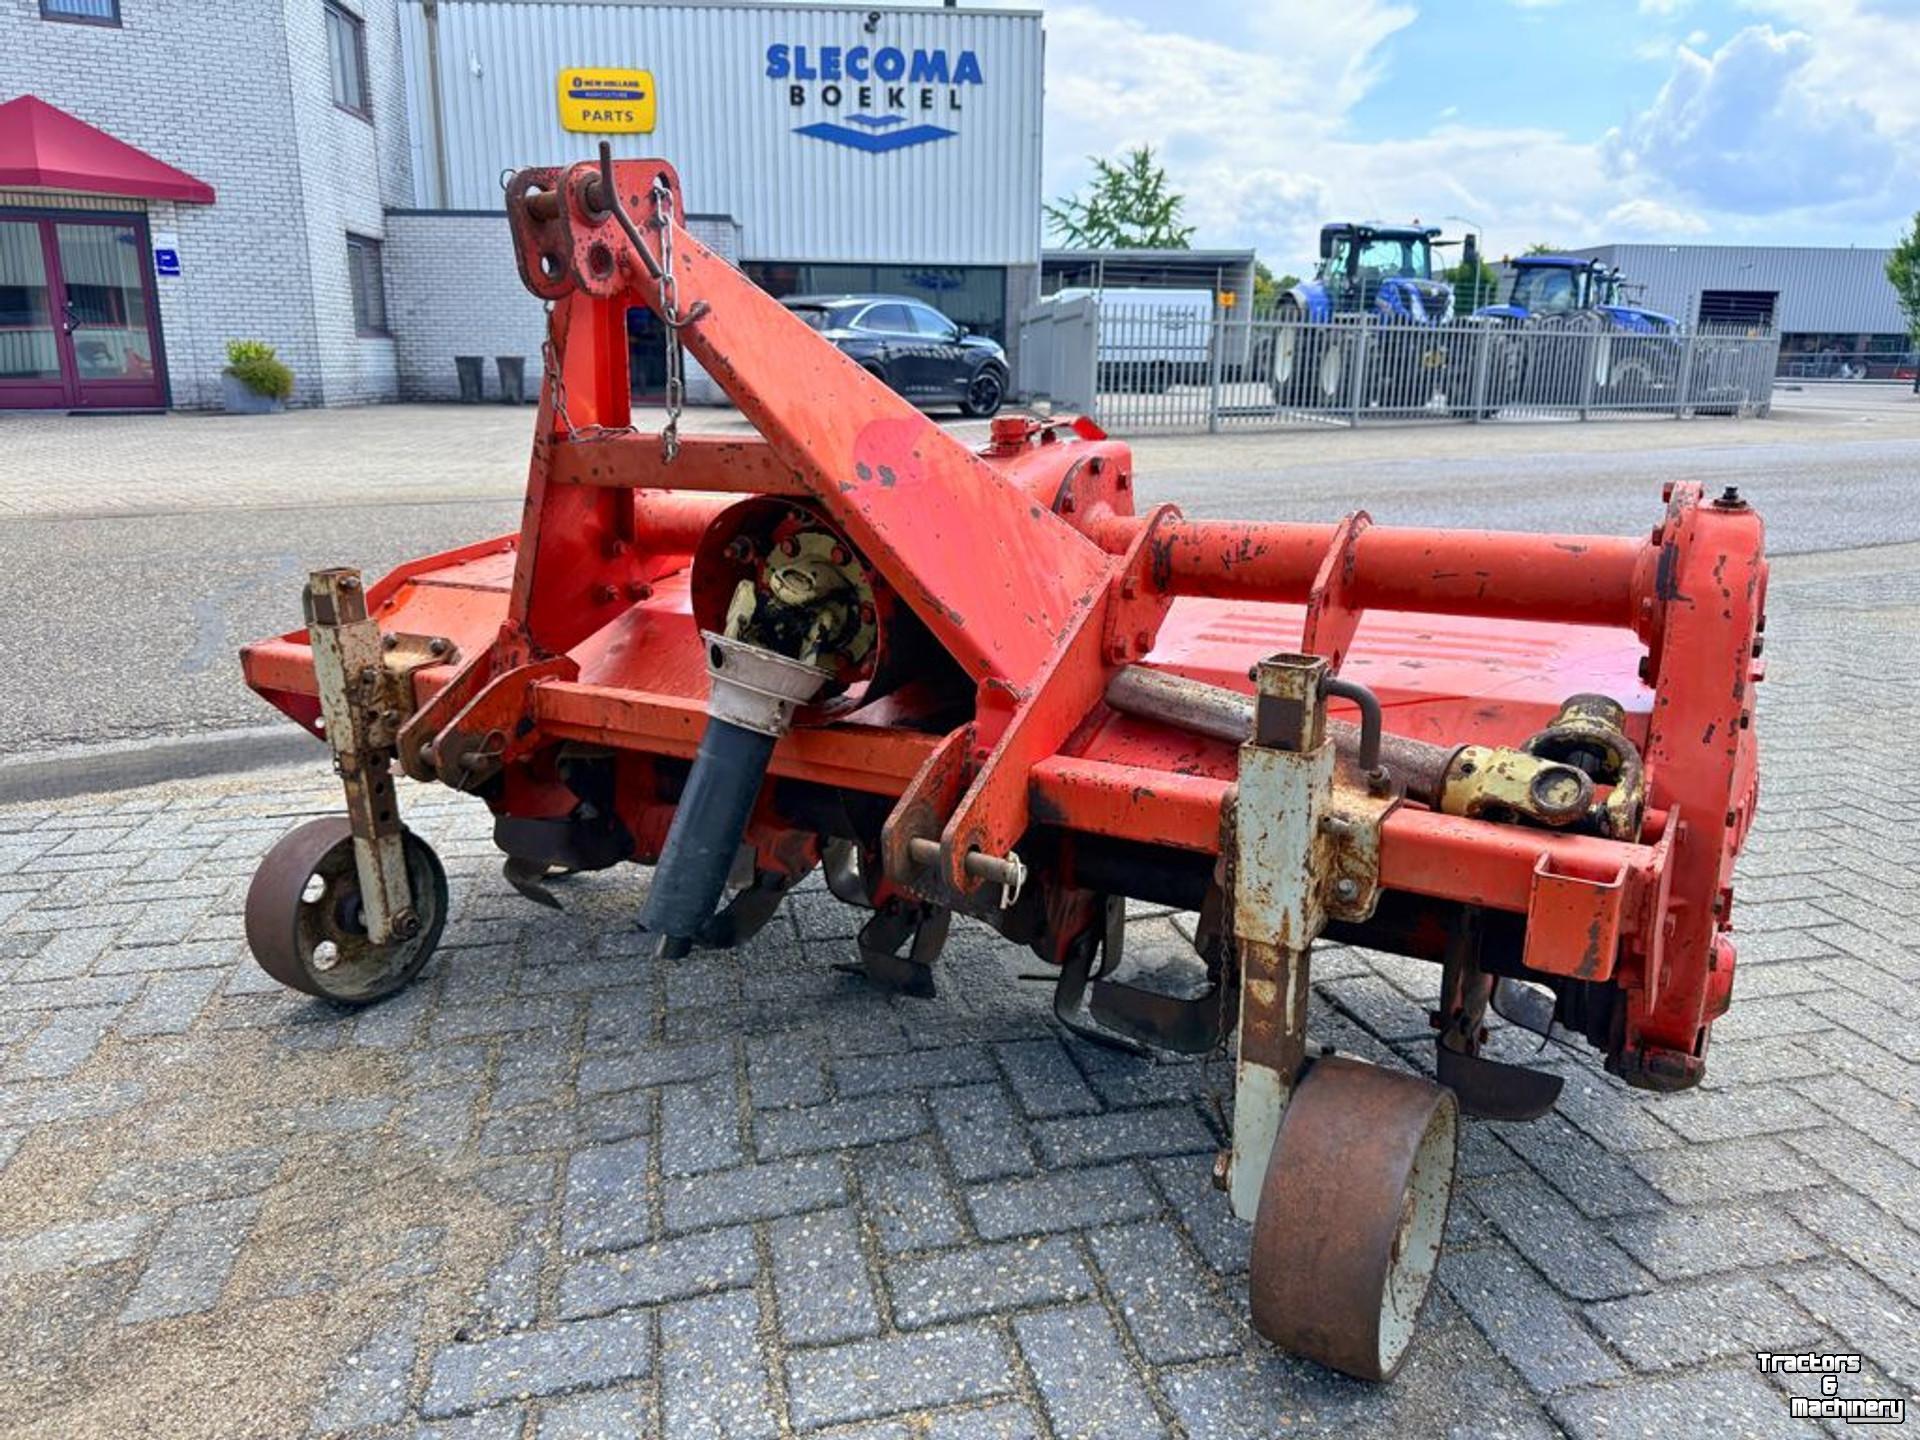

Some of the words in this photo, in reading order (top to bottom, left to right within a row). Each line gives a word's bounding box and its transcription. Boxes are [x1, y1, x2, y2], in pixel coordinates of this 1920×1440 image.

[766, 44, 983, 84] SLECOMA
[790, 85, 962, 110] BOEKEL
[582, 110, 634, 122] PARTS
